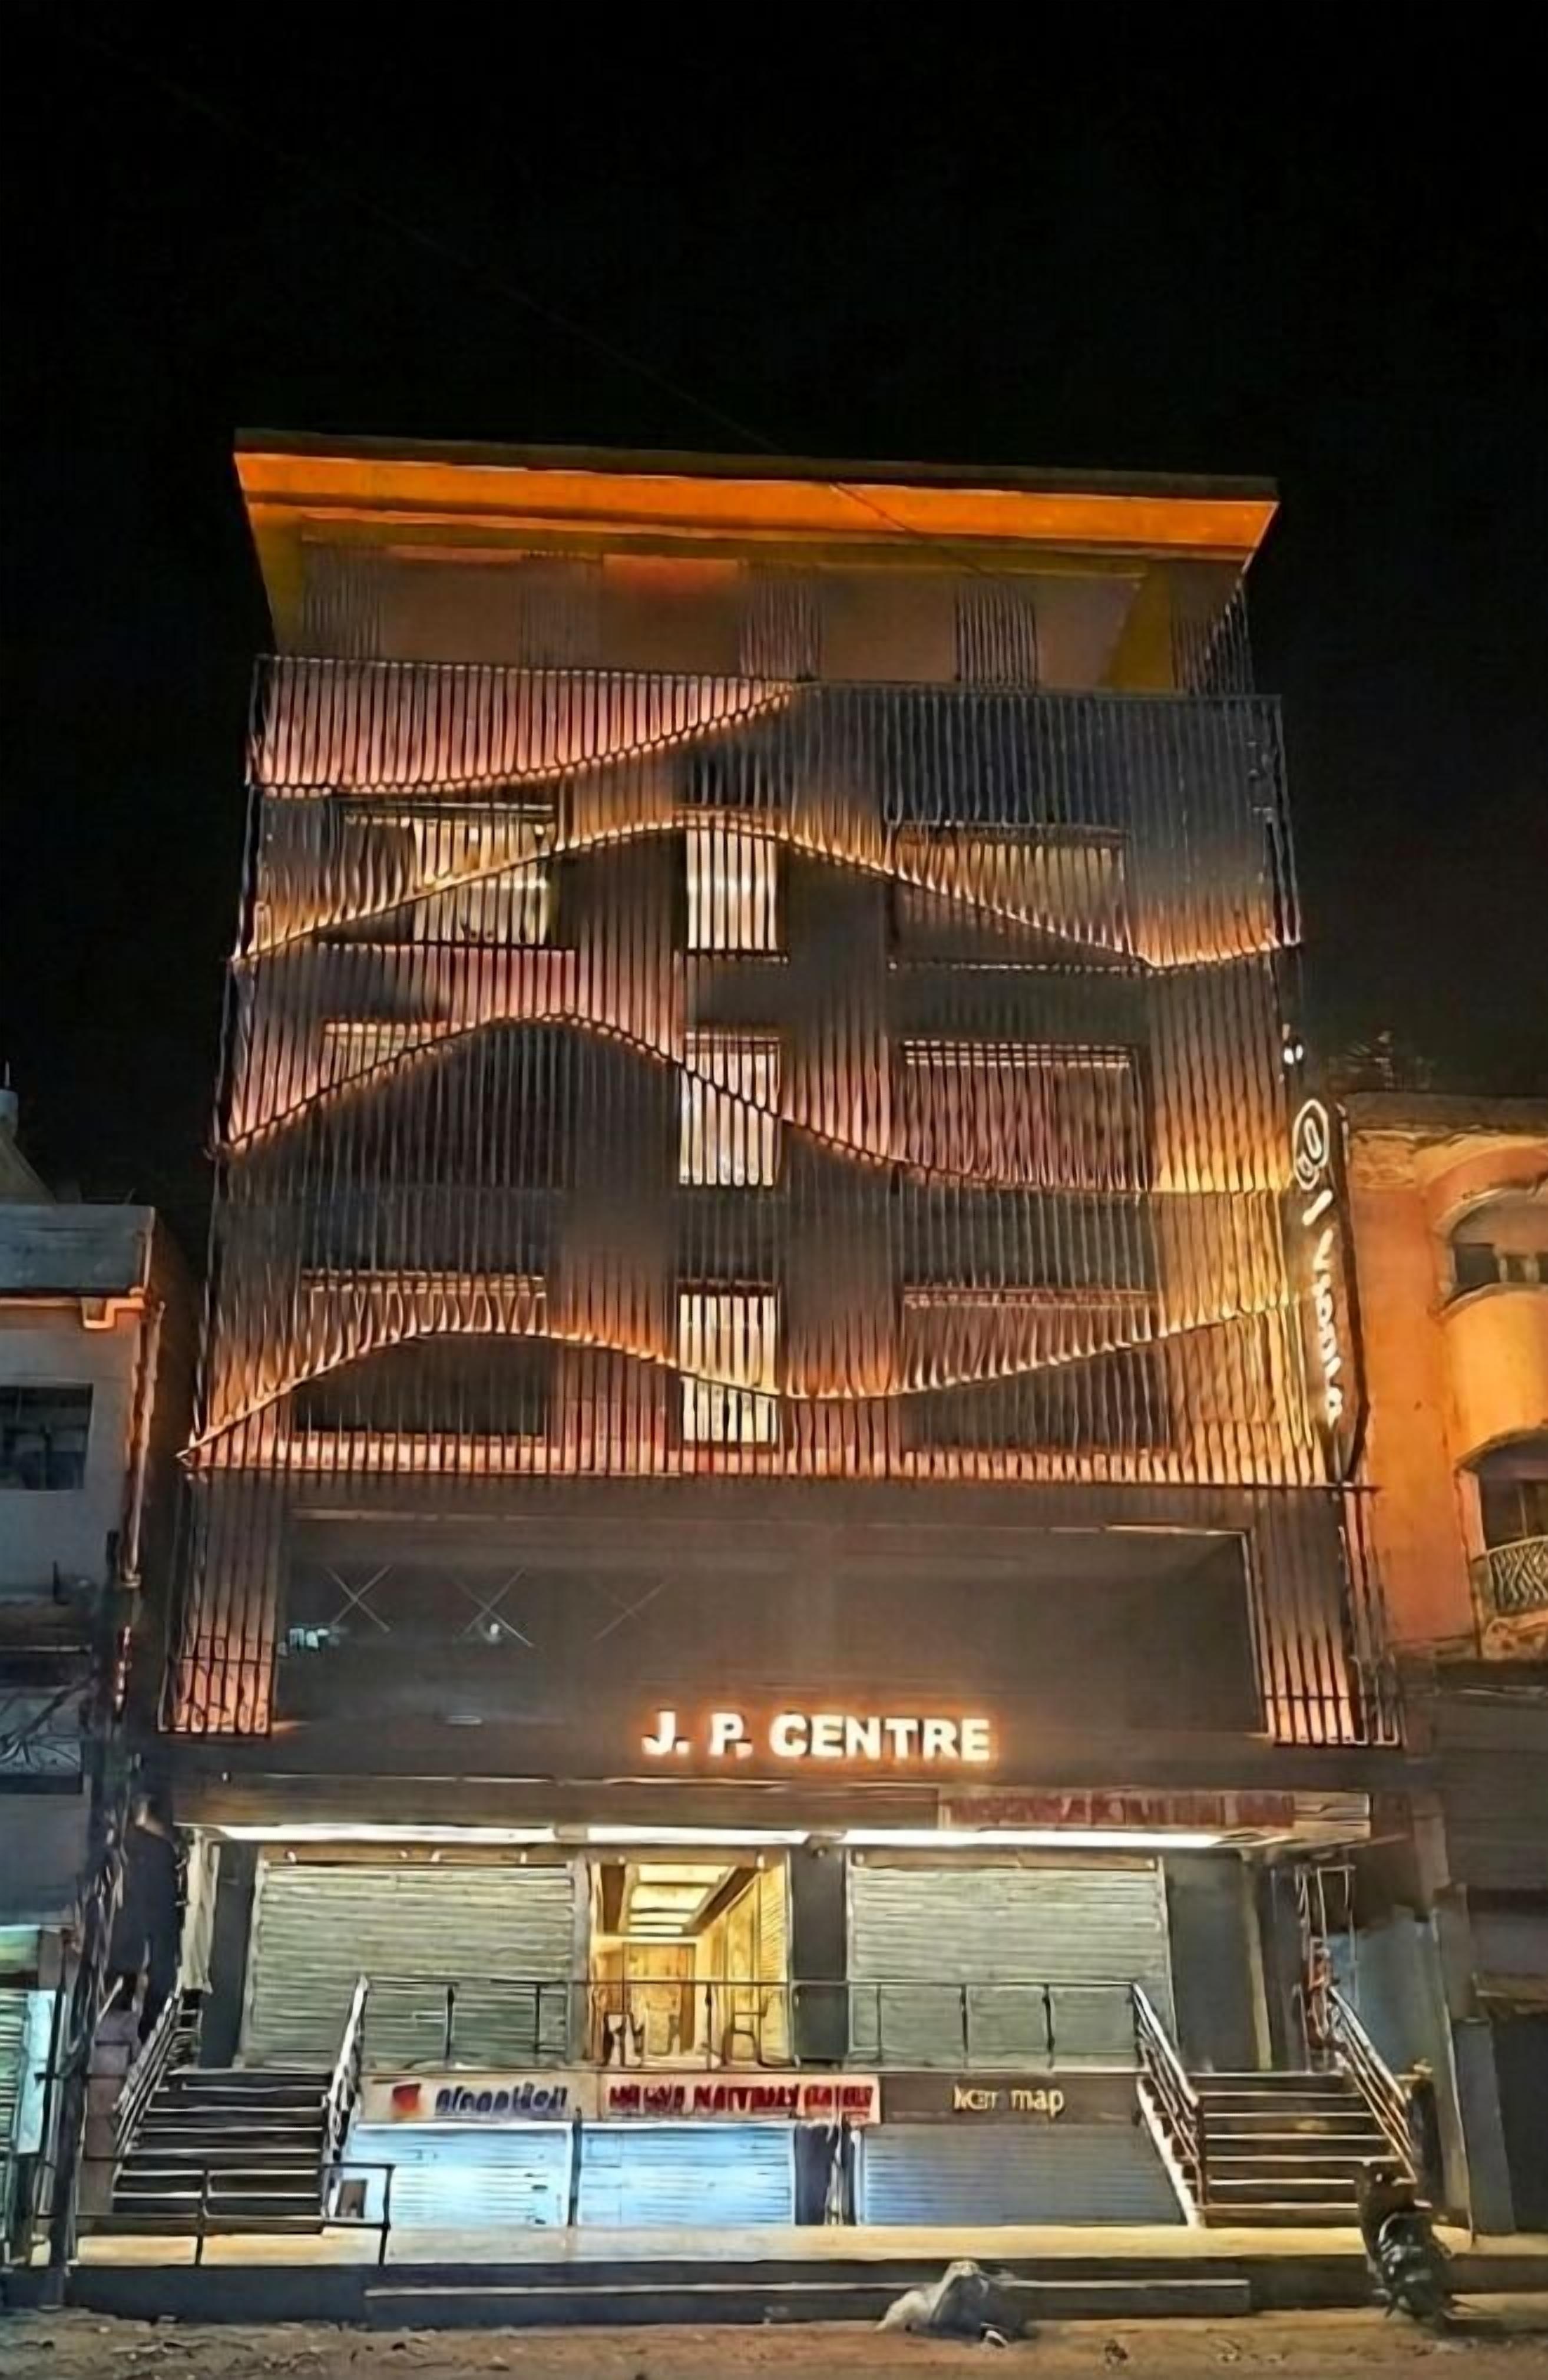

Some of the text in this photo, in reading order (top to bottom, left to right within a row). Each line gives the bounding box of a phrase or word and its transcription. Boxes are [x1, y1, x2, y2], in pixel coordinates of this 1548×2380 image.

[641, 1710, 991, 1761] J. P. CENTRE
